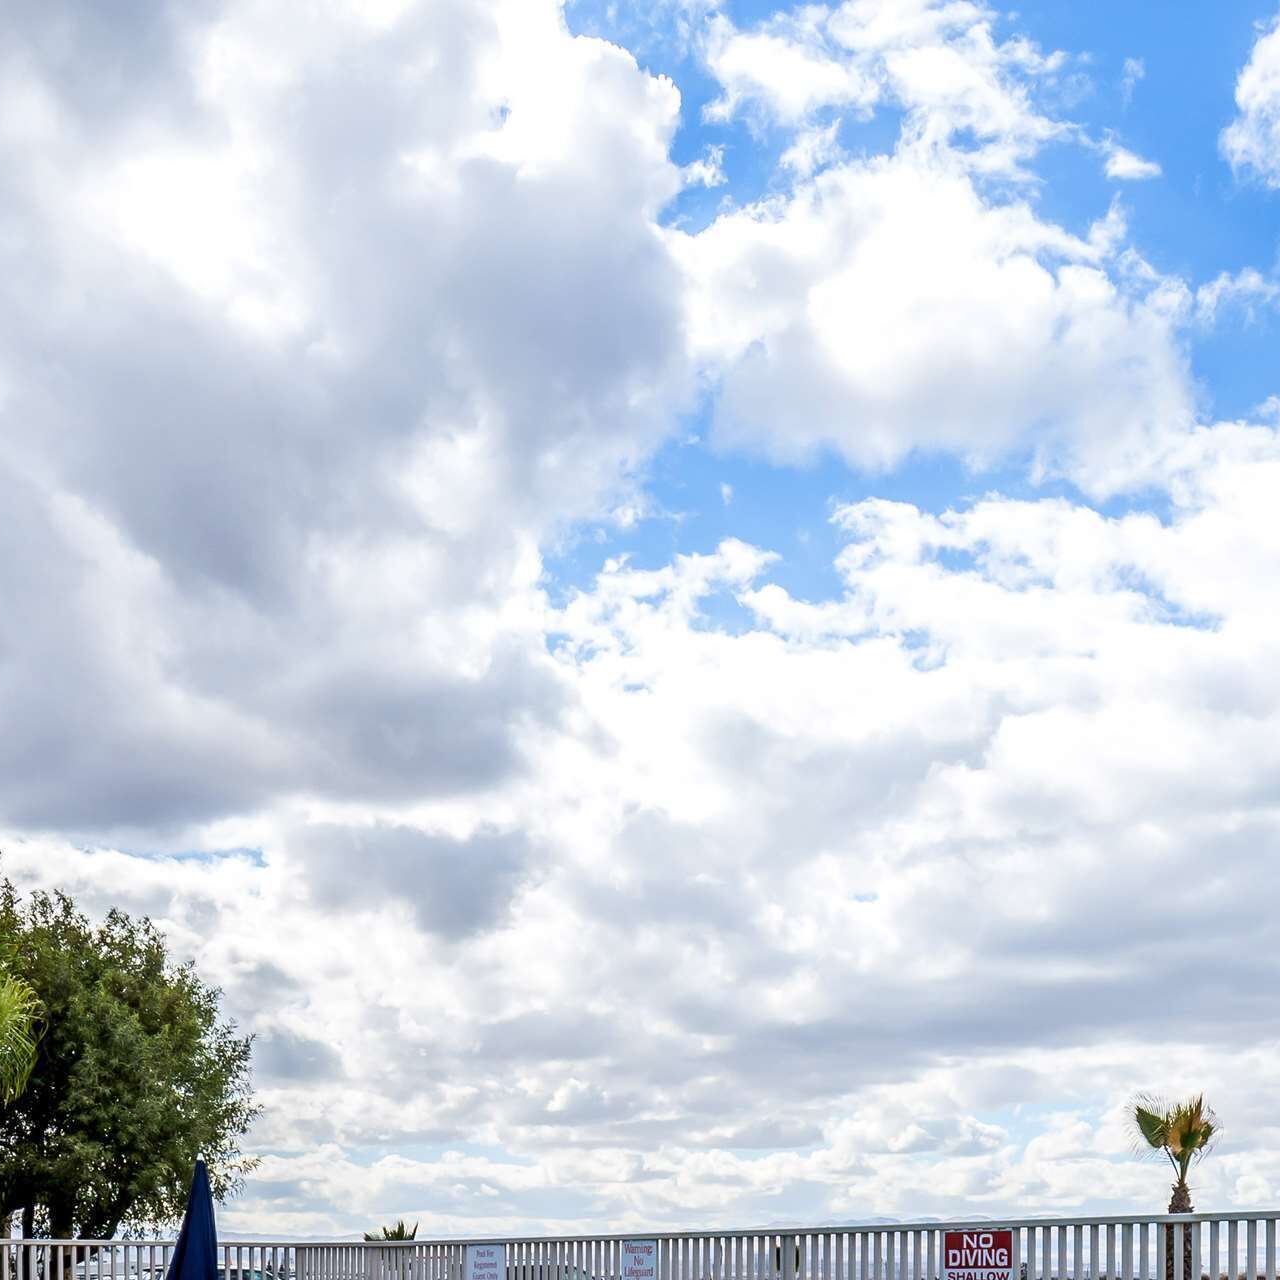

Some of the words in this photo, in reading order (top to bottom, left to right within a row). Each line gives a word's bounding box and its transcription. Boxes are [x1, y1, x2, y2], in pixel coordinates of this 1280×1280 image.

[963, 1233, 993, 1249] NO
[633, 1256, 644, 1266] No
[948, 1248, 1008, 1267] DIVING
